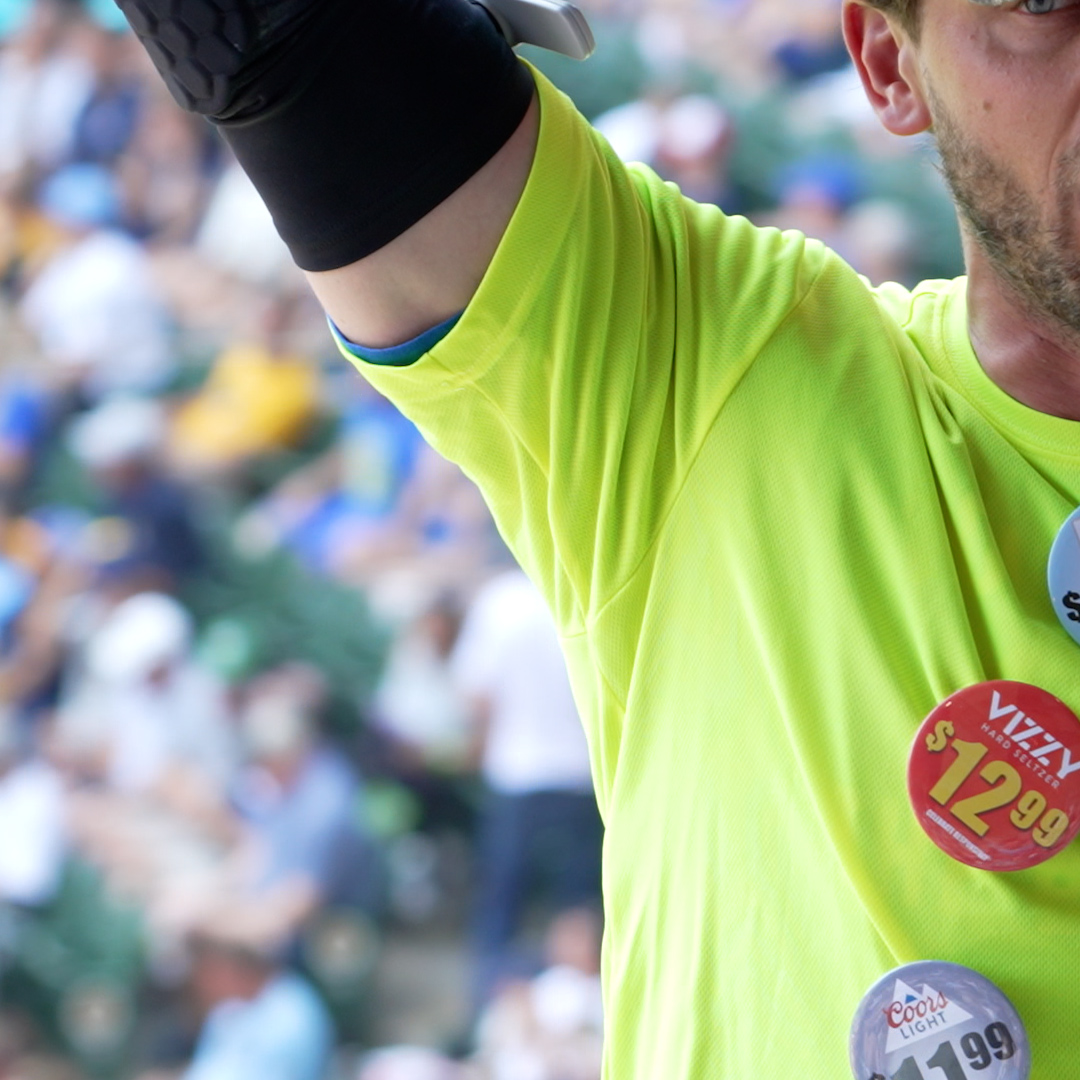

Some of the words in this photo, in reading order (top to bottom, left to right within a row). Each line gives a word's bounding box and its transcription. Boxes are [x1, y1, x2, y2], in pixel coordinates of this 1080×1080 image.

[980, 723, 1012, 750] HARD
[1012, 749, 1061, 790] SELTZER
[882, 991, 949, 1029] Coors
[900, 1011, 947, 1040] LIGHT
